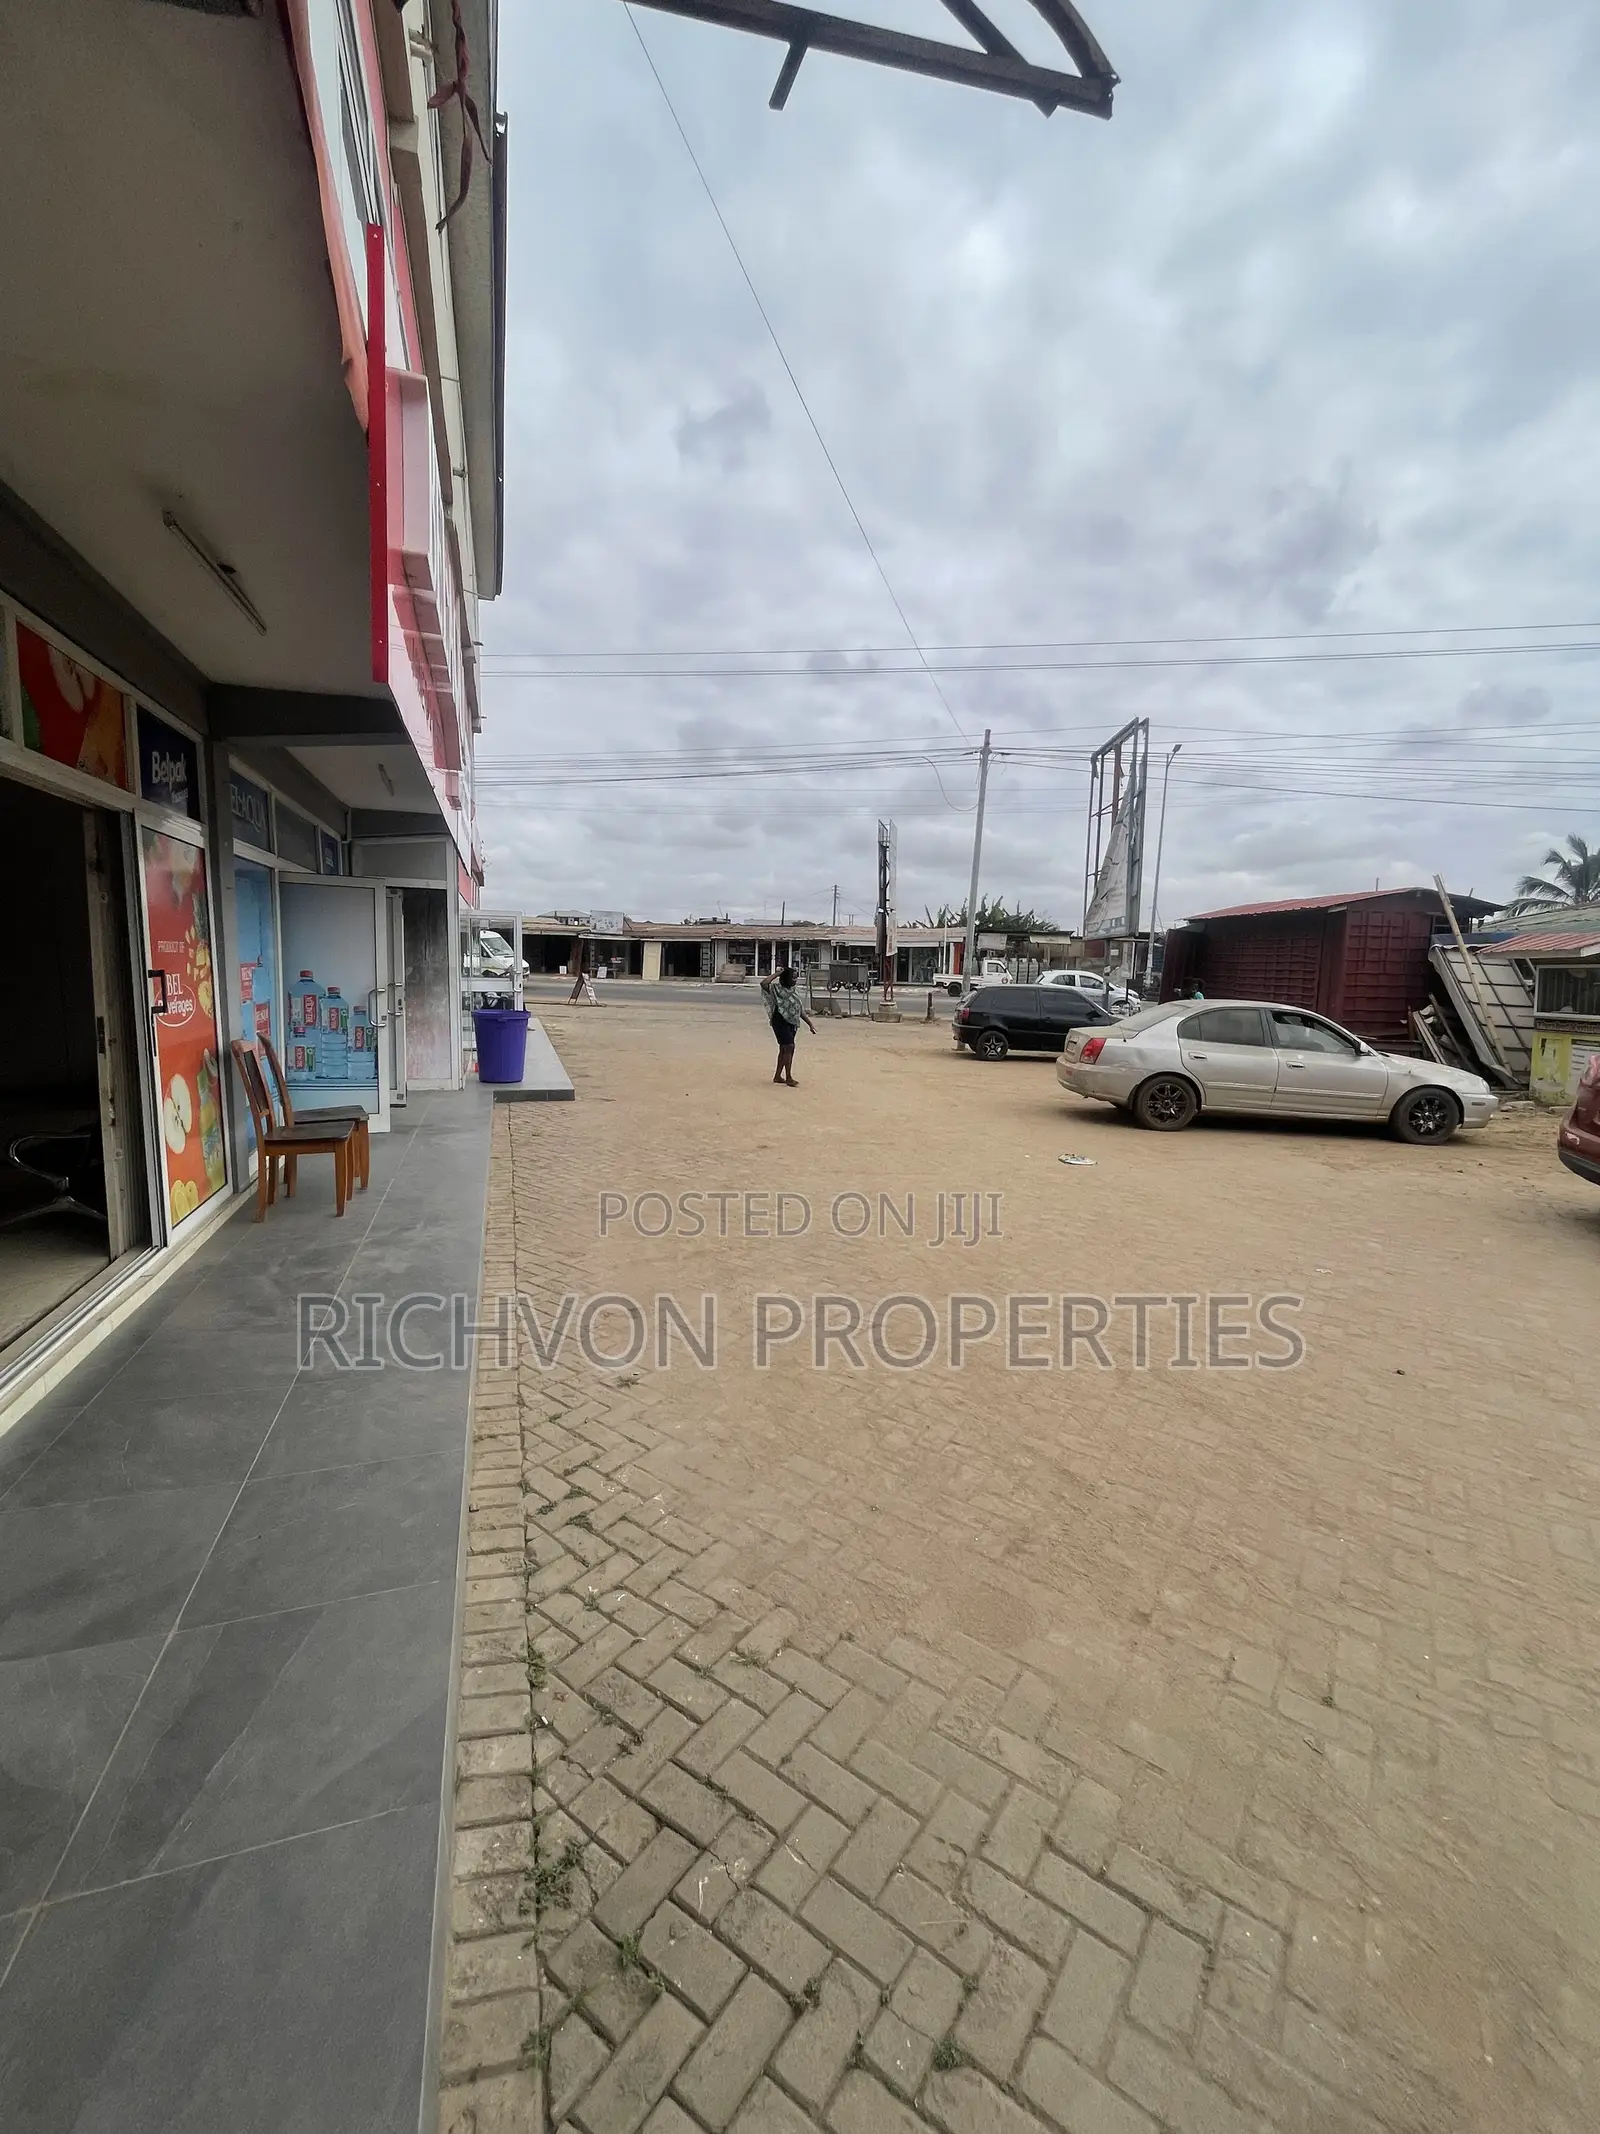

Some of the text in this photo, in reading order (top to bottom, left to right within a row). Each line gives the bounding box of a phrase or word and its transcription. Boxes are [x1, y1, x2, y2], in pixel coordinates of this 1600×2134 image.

[151, 751, 187, 792] Belpak
[157, 940, 185, 953] PRODUCT OF
[165, 973, 184, 996] BEL
